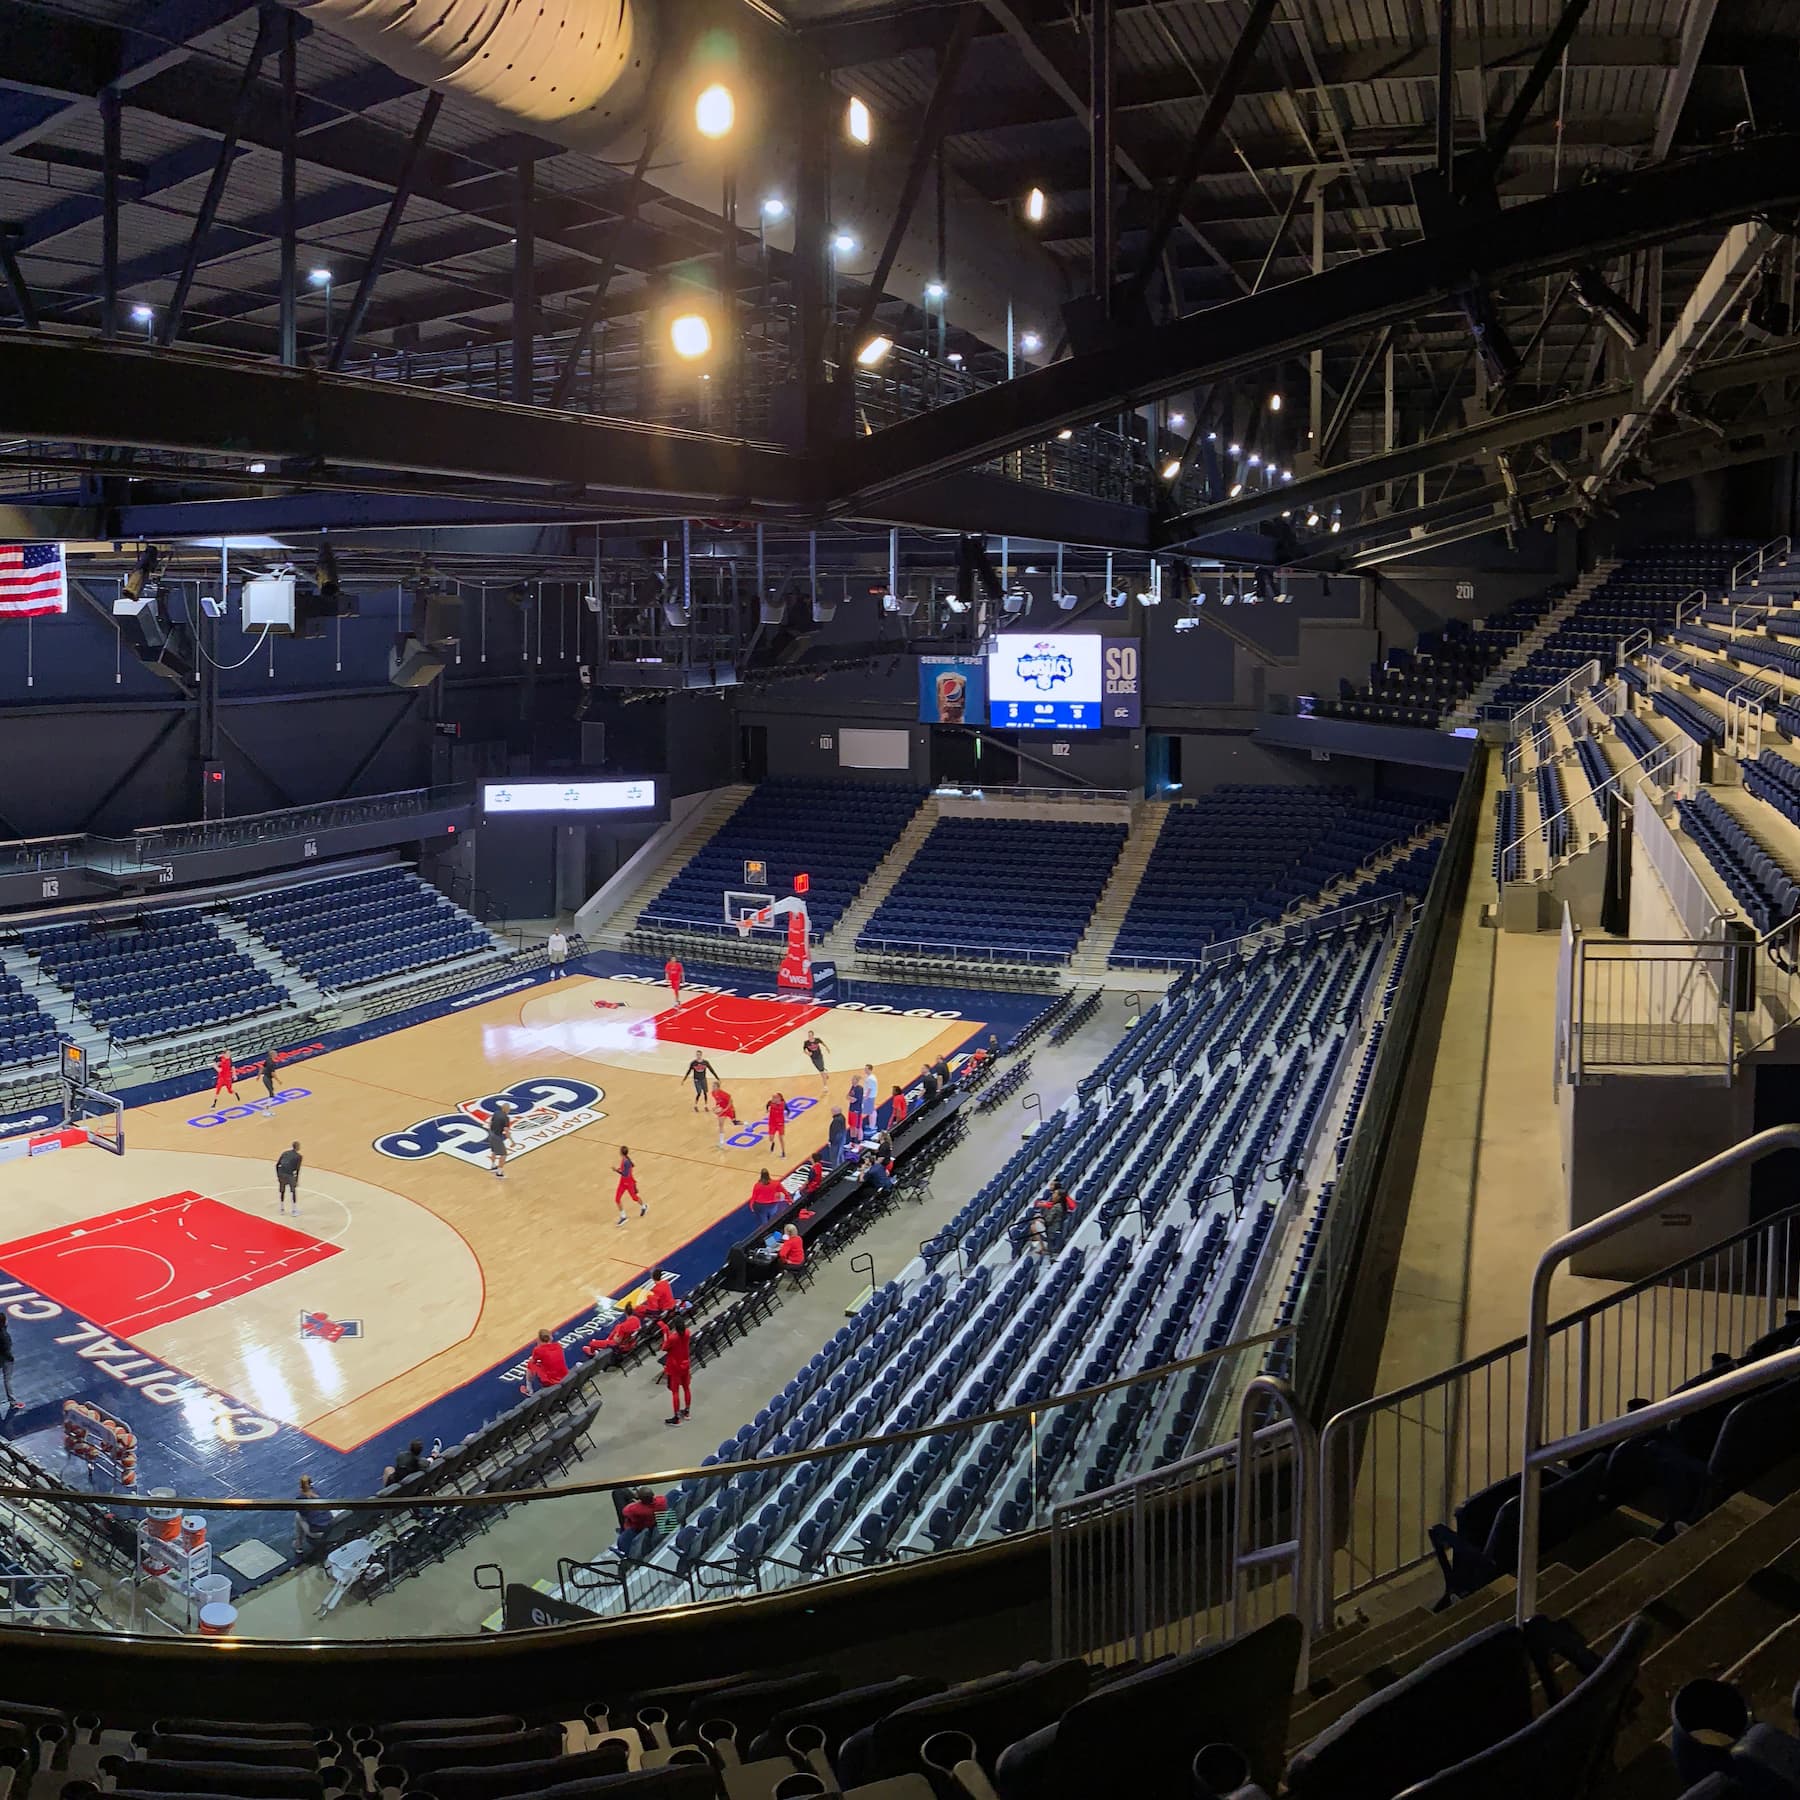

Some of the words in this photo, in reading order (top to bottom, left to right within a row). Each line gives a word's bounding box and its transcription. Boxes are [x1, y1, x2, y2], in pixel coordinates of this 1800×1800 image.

[1455, 585, 1474, 599] 201
[1105, 647, 1137, 680] SO
[1106, 680, 1137, 693] CLOSE
[42, 880, 59, 898] 113
[748, 992, 836, 1005] CITY
[835, 1002, 964, 1020] GO-GO
[523, 1112, 593, 1142] CAPITAL
